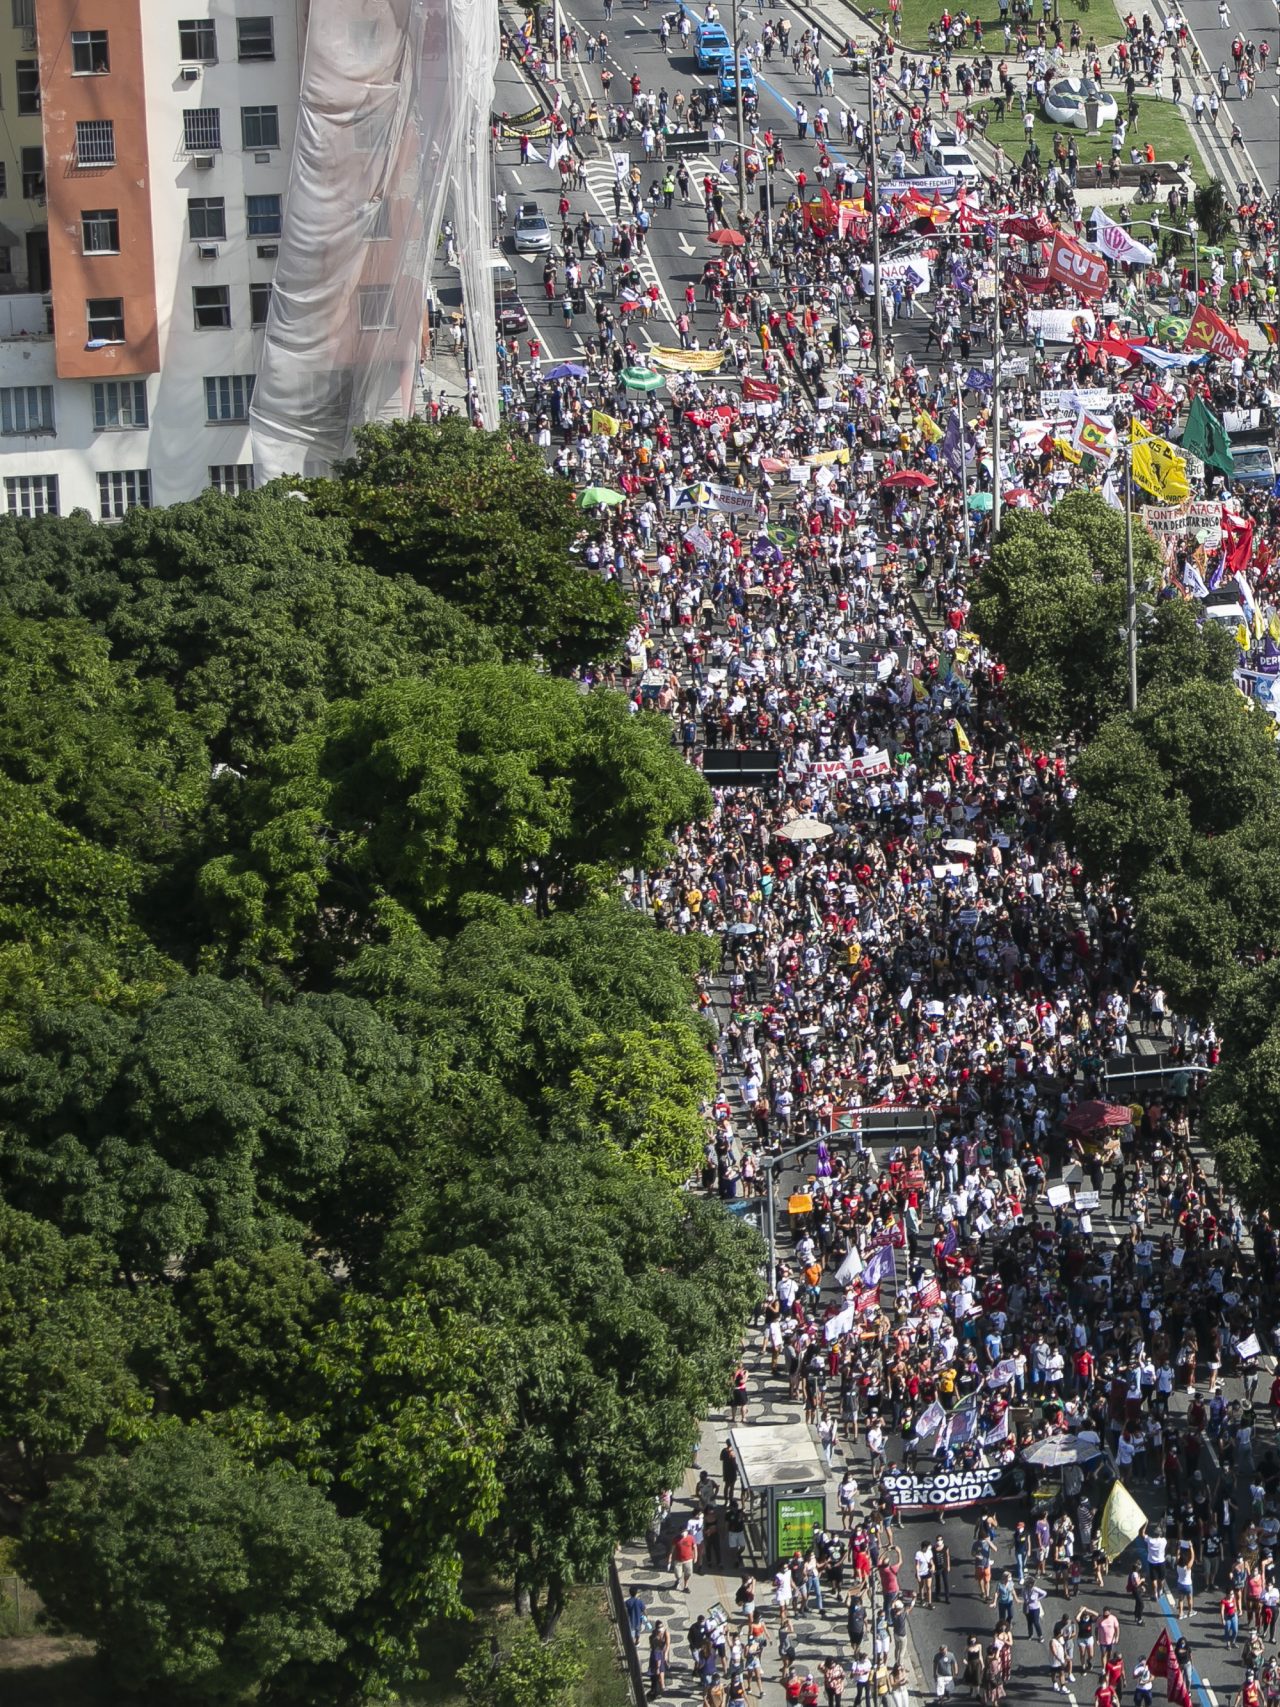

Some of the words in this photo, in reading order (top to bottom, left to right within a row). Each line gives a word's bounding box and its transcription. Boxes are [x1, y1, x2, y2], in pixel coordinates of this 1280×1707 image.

[929, 178, 954, 187] FECHAR!
[1057, 247, 1105, 282] CUT
[1211, 330, 1240, 358] PCdo
[1148, 520, 1169, 531] PARA
[805, 762, 847, 773] VIVA
[852, 759, 864, 768] A
[883, 1468, 1002, 1490] BOLSONARO
